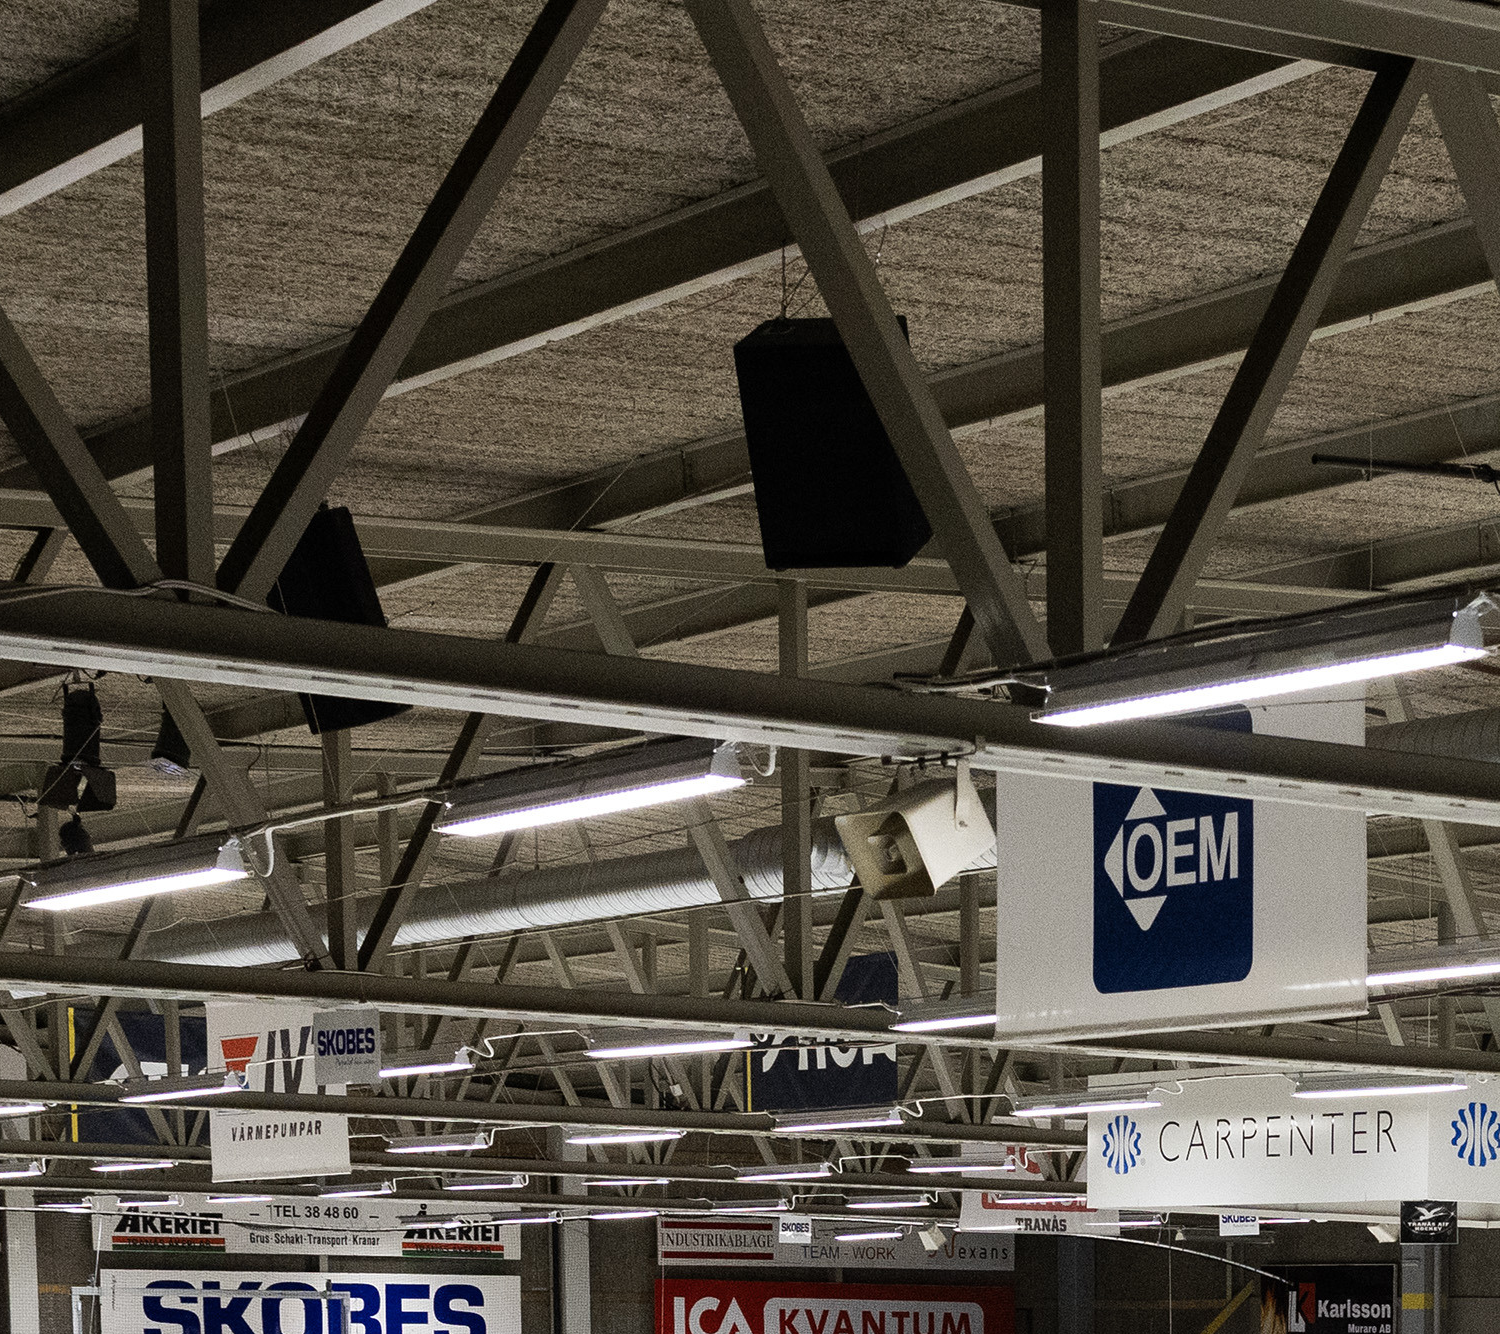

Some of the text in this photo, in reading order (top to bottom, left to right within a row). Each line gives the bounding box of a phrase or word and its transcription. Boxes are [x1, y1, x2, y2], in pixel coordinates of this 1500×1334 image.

[1126, 811, 1238, 893] OEM
[318, 1028, 375, 1056] SKOBES
[232, 1120, 322, 1142] VÄRMEPUMPAR
[1159, 1109, 1398, 1162] CARPENTER
[275, 1206, 301, 1219] TEL
[305, 1206, 321, 1219] 38
[324, 1207, 340, 1219] 48
[343, 1207, 359, 1219] 60
[781, 1222, 810, 1235] SKOBES
[660, 1231, 775, 1250] INDUSTRIKABLAGE
[801, 1245, 896, 1261] TEAM WORK
[1317, 1299, 1391, 1319] Karlsson
[1347, 1323, 1391, 1334] Murare AB
